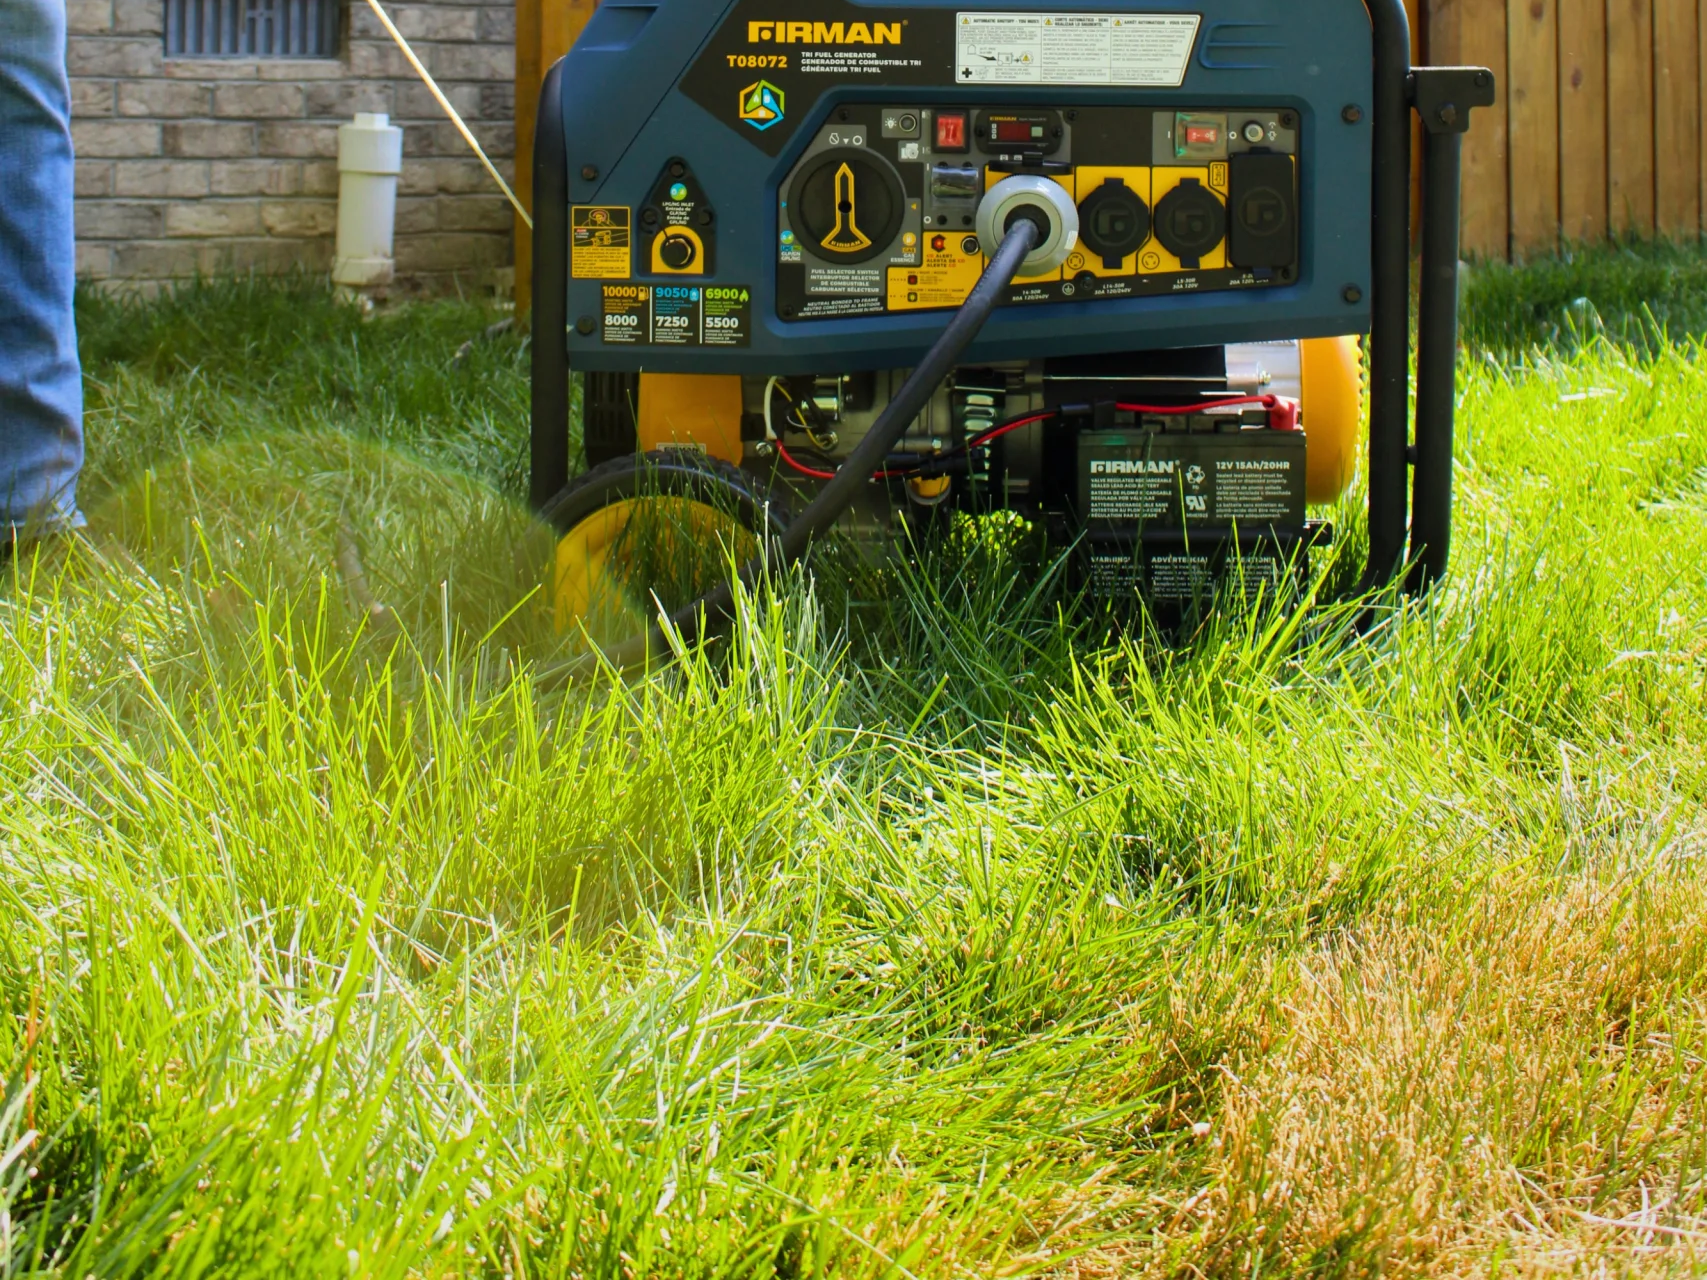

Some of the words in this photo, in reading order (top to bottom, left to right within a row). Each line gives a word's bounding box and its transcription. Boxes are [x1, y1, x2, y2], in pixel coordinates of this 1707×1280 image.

[748, 21, 901, 44] FIRMAN
[727, 55, 787, 68] T08072
[603, 286, 637, 297] 10000
[656, 288, 688, 298] 9050
[706, 288, 738, 299] 6900
[605, 315, 637, 326] 8000
[656, 316, 688, 327] 7250
[706, 317, 738, 328] 5500
[1091, 461, 1174, 473] FIRMAN
[1236, 461, 1290, 470] 15Ah/20HR
